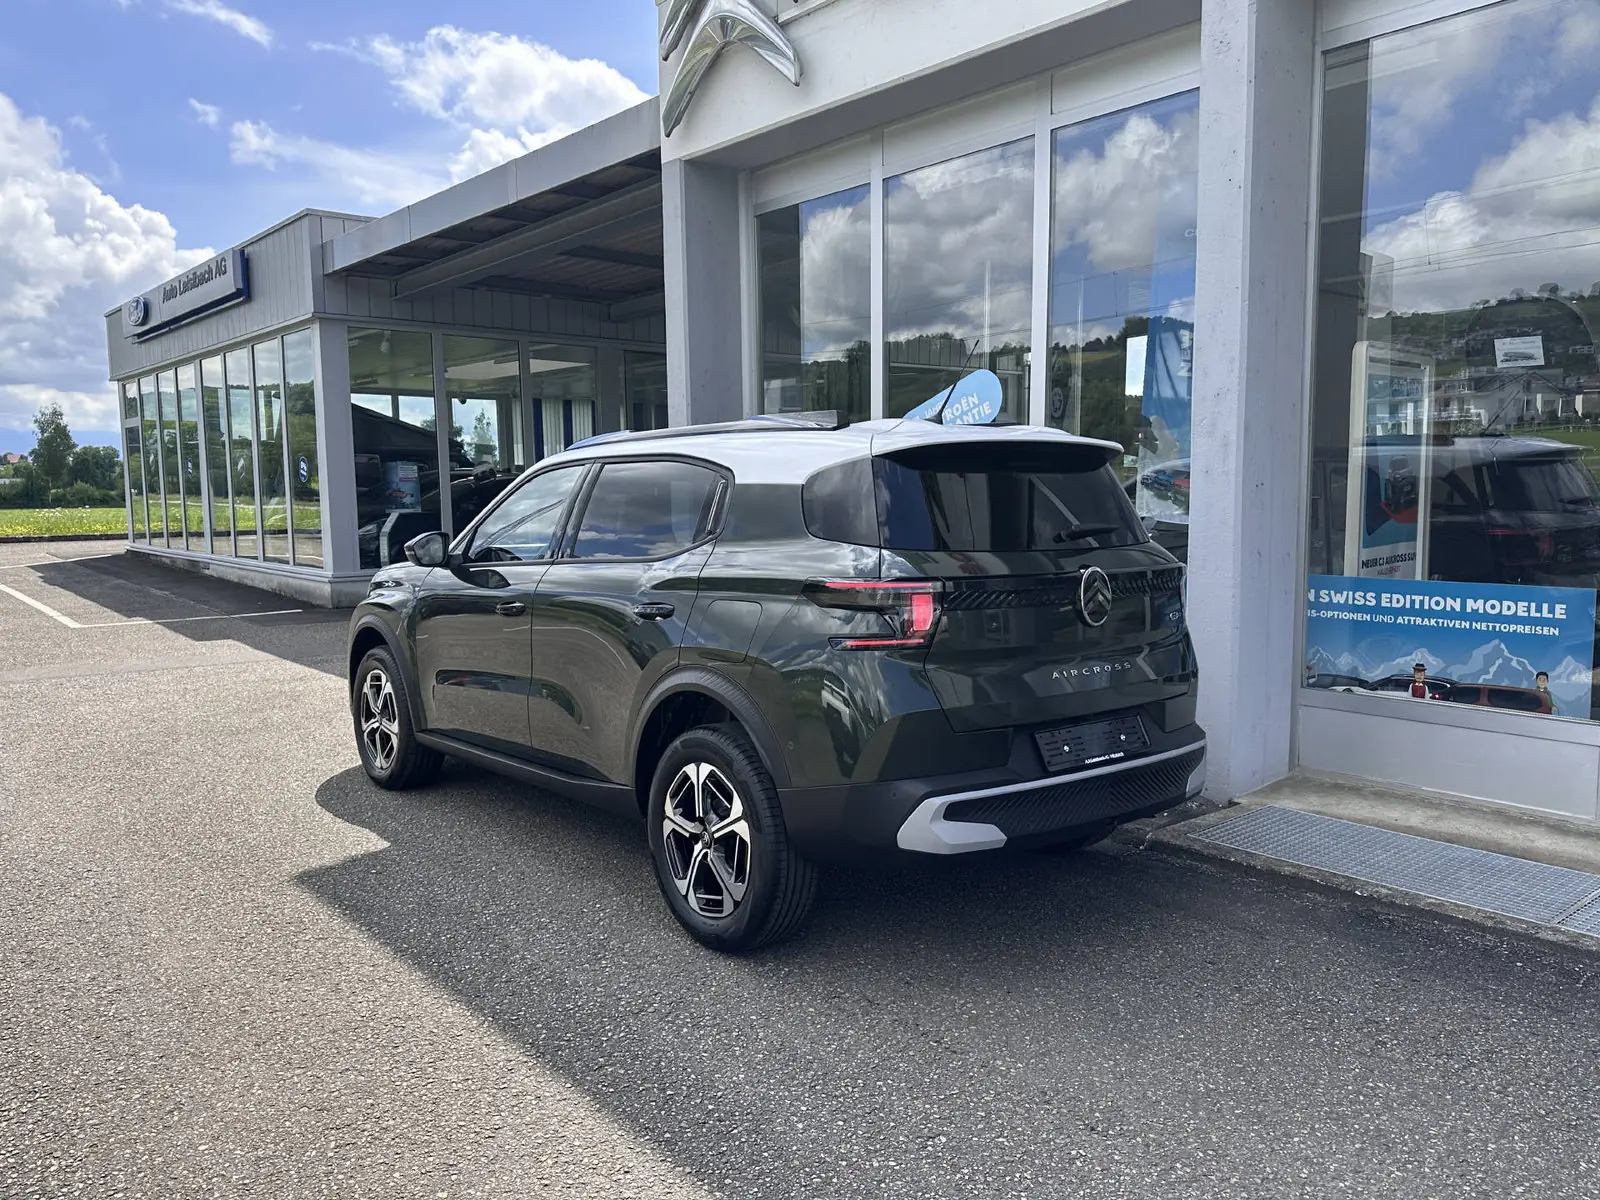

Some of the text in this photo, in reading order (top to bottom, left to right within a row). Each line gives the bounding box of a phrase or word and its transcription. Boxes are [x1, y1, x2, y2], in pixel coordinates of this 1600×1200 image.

[162, 284, 177, 304] Auto
[214, 257, 227, 279] AG
[955, 401, 992, 424] ANTIE
[1361, 557, 1378, 569] NEUER
[1319, 589, 1377, 606] SWISS
[1381, 593, 1461, 612] EDITION
[1466, 598, 1567, 619] MODELLE
[1307, 609, 1560, 636] IS-OPTIONEN UND ATTRAKTIVEN NETTOPREISEN
[1052, 662, 1131, 679] AIRCROSS
